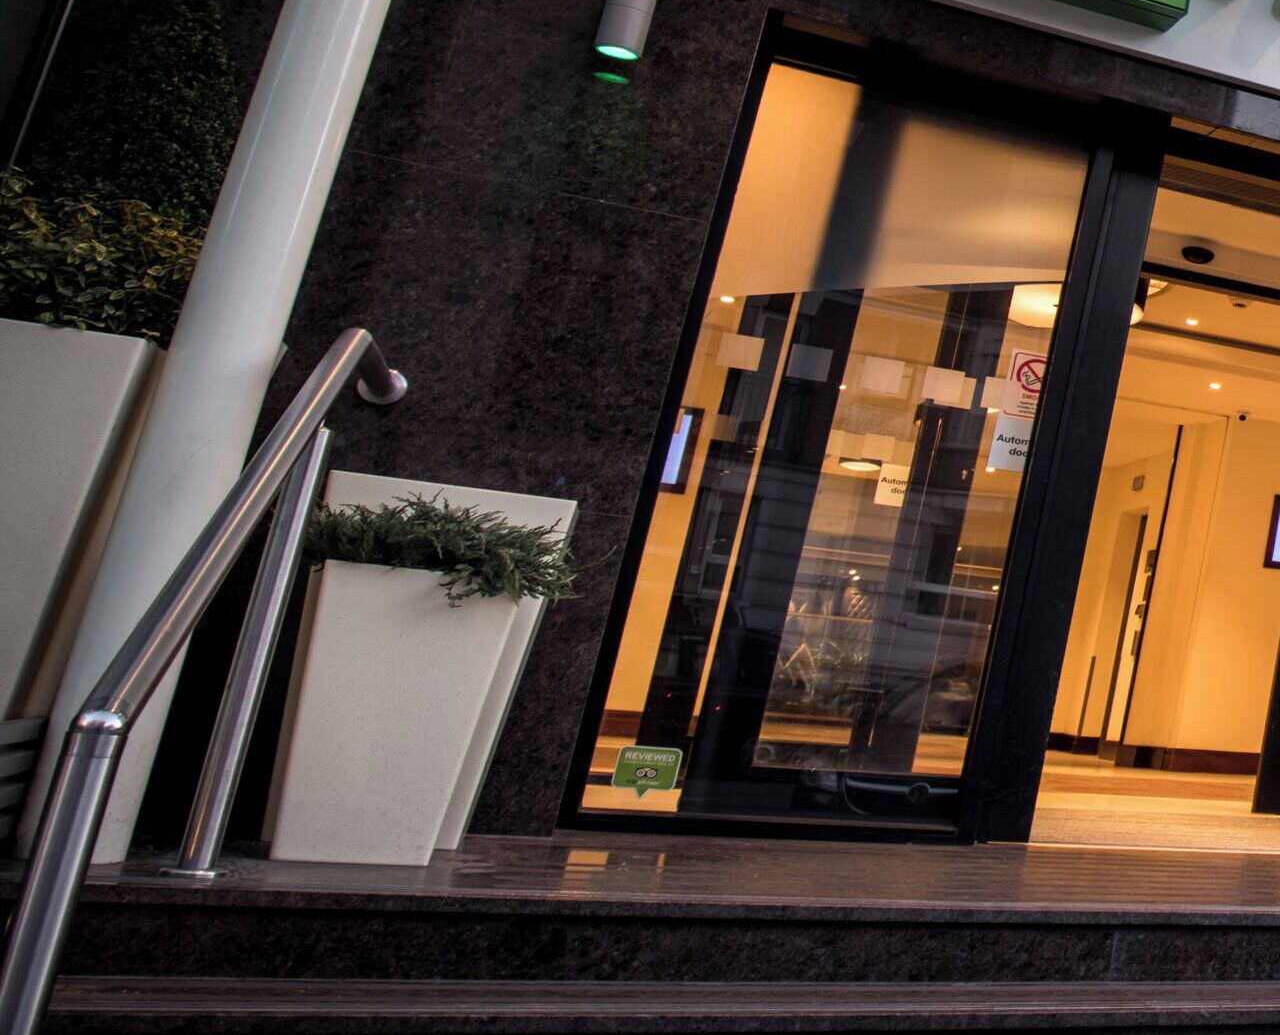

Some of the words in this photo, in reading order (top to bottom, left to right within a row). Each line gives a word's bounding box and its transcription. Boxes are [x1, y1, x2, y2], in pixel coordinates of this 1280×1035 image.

[996, 434, 1031, 446] Autom
[1008, 447, 1029, 457] doo
[624, 751, 676, 762] REVIEWED
